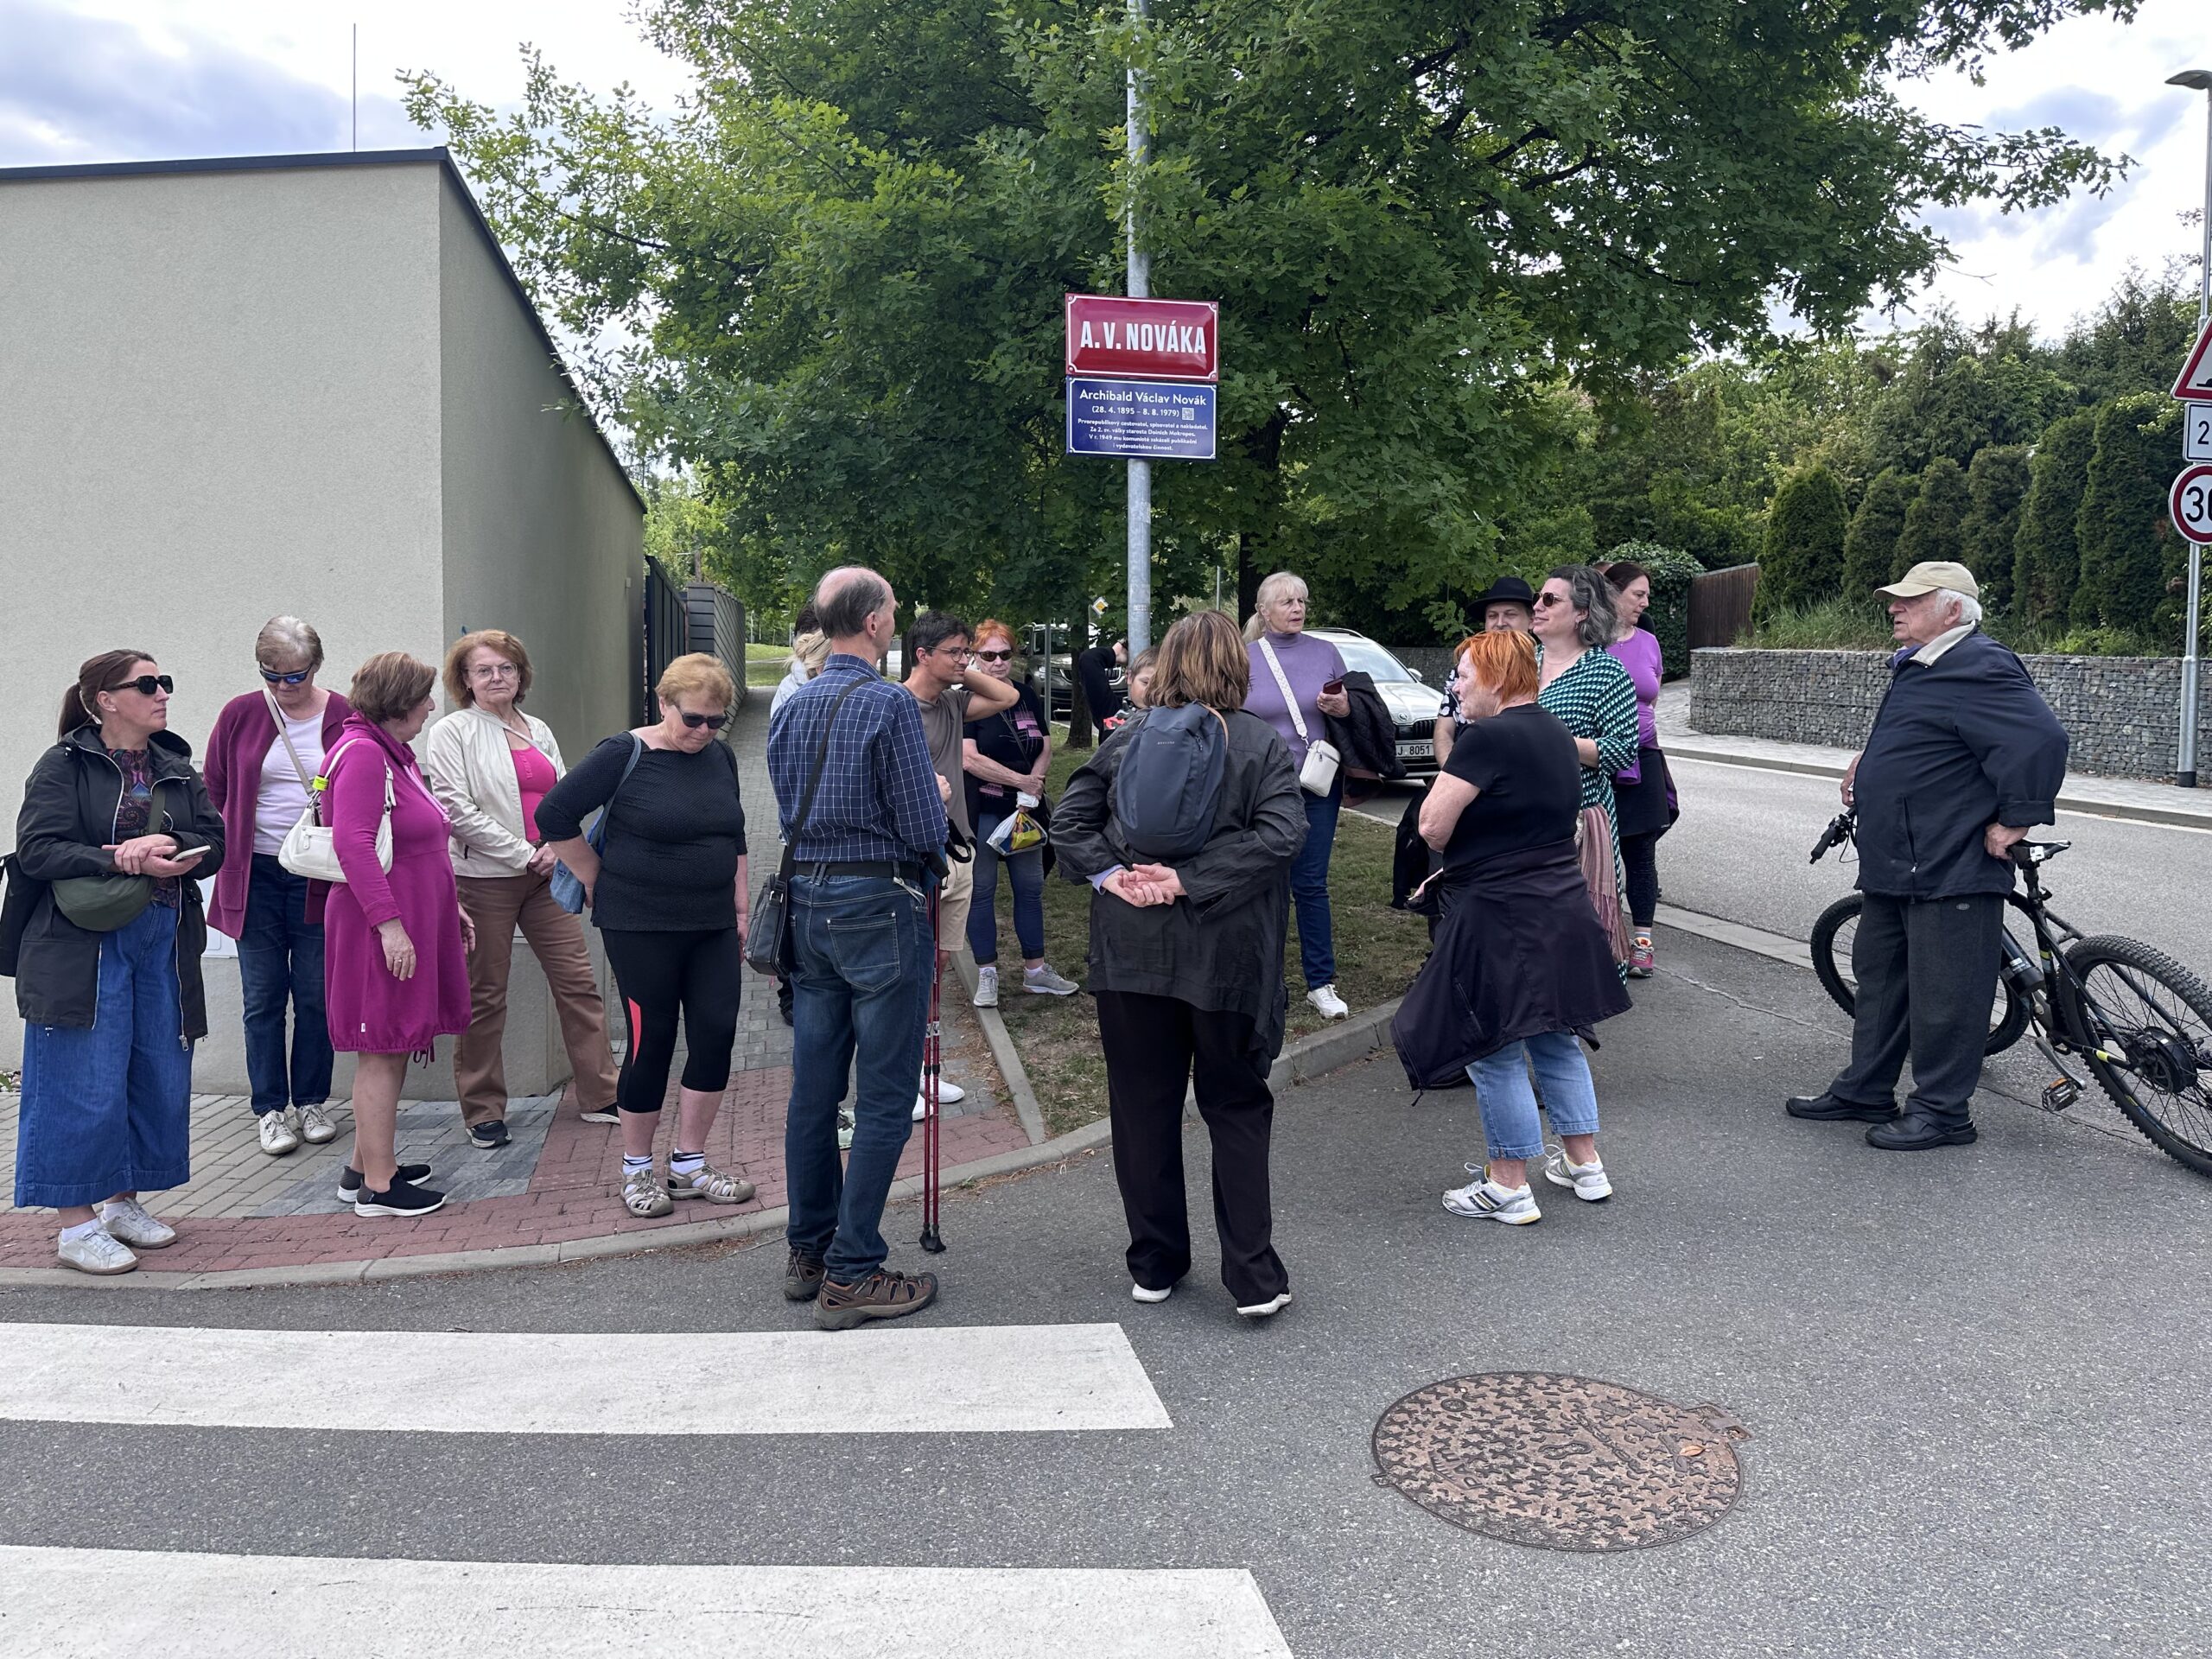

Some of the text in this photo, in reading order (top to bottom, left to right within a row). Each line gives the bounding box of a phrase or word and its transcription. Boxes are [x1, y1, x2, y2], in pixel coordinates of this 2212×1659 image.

[1080, 320, 1206, 354] A. V. NOVÁKA
[1079, 388, 1207, 406] Archibald Václav Novák
[1091, 405, 1107, 414] (28.
[1160, 409, 1179, 417] 1979)
[1077, 418, 1120, 427] Prvorepublikový
[2185, 486, 2212, 523] 3
[1409, 745, 1430, 755] 8051
